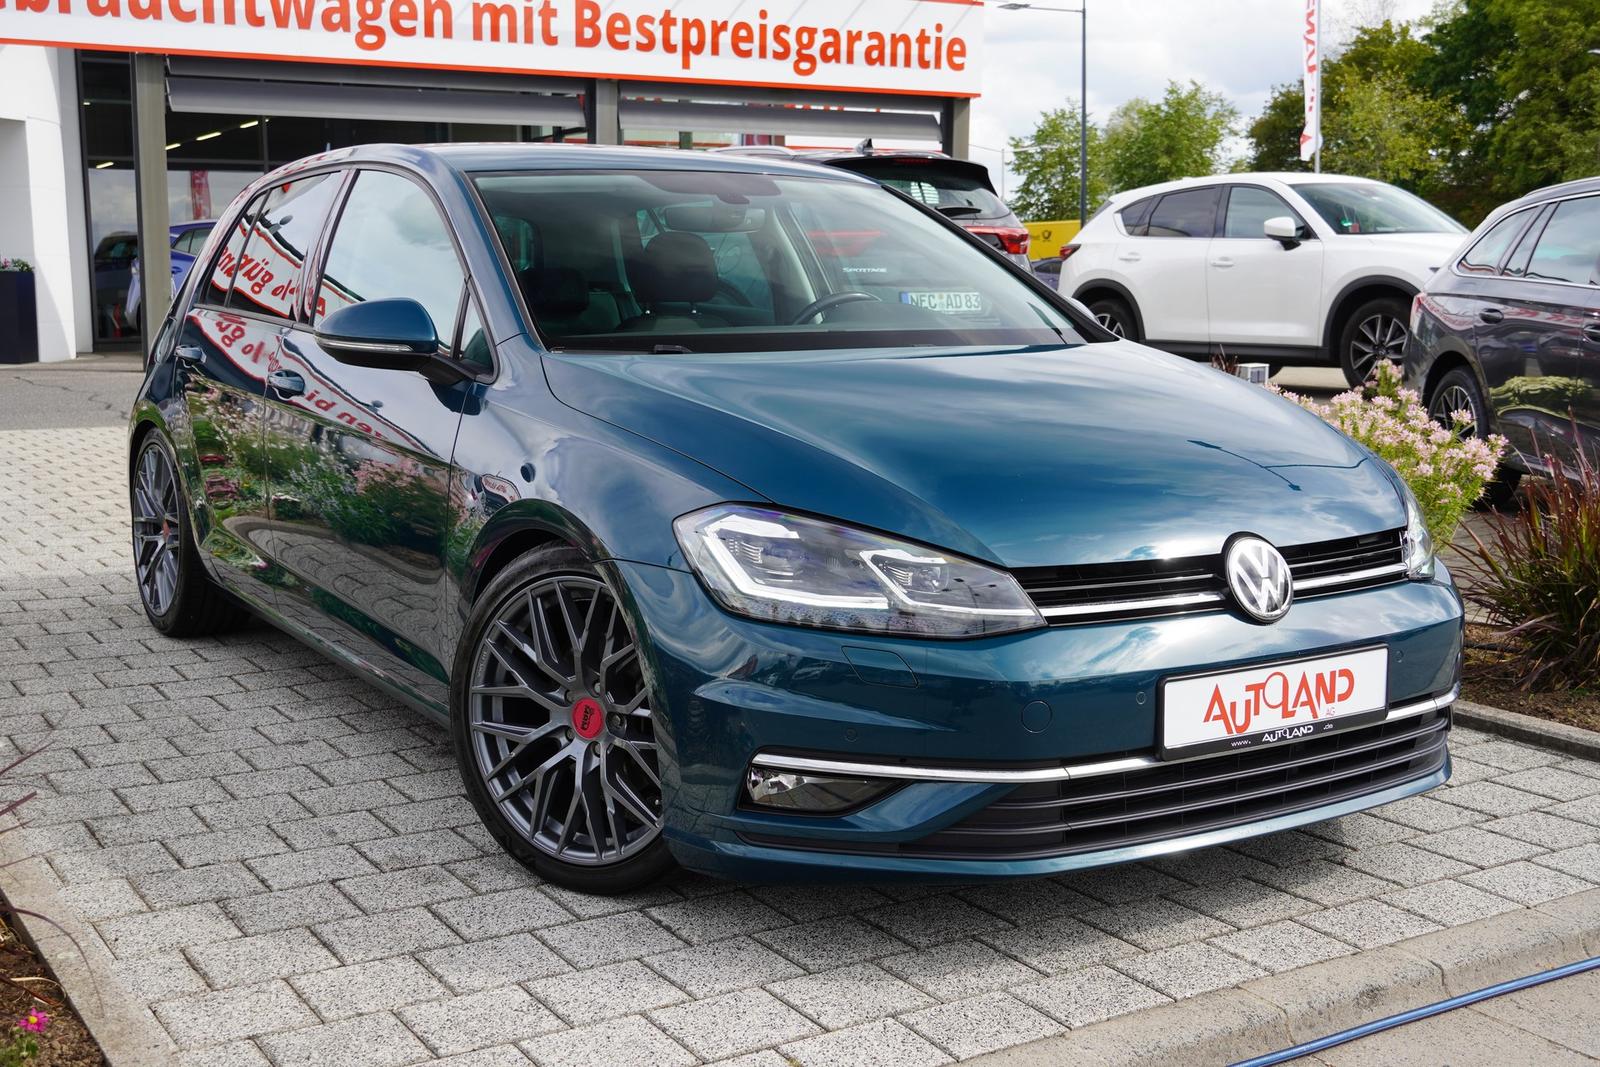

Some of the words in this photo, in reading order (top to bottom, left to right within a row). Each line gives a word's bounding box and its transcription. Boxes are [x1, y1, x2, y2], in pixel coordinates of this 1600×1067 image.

[472, 0, 558, 46] mit
[574, 0, 967, 76] Bestpreisgarantie
[1227, 535, 1292, 621] VW
[1203, 668, 1354, 735] AUTOLAND
[1262, 724, 1314, 743] AUTOLAND
